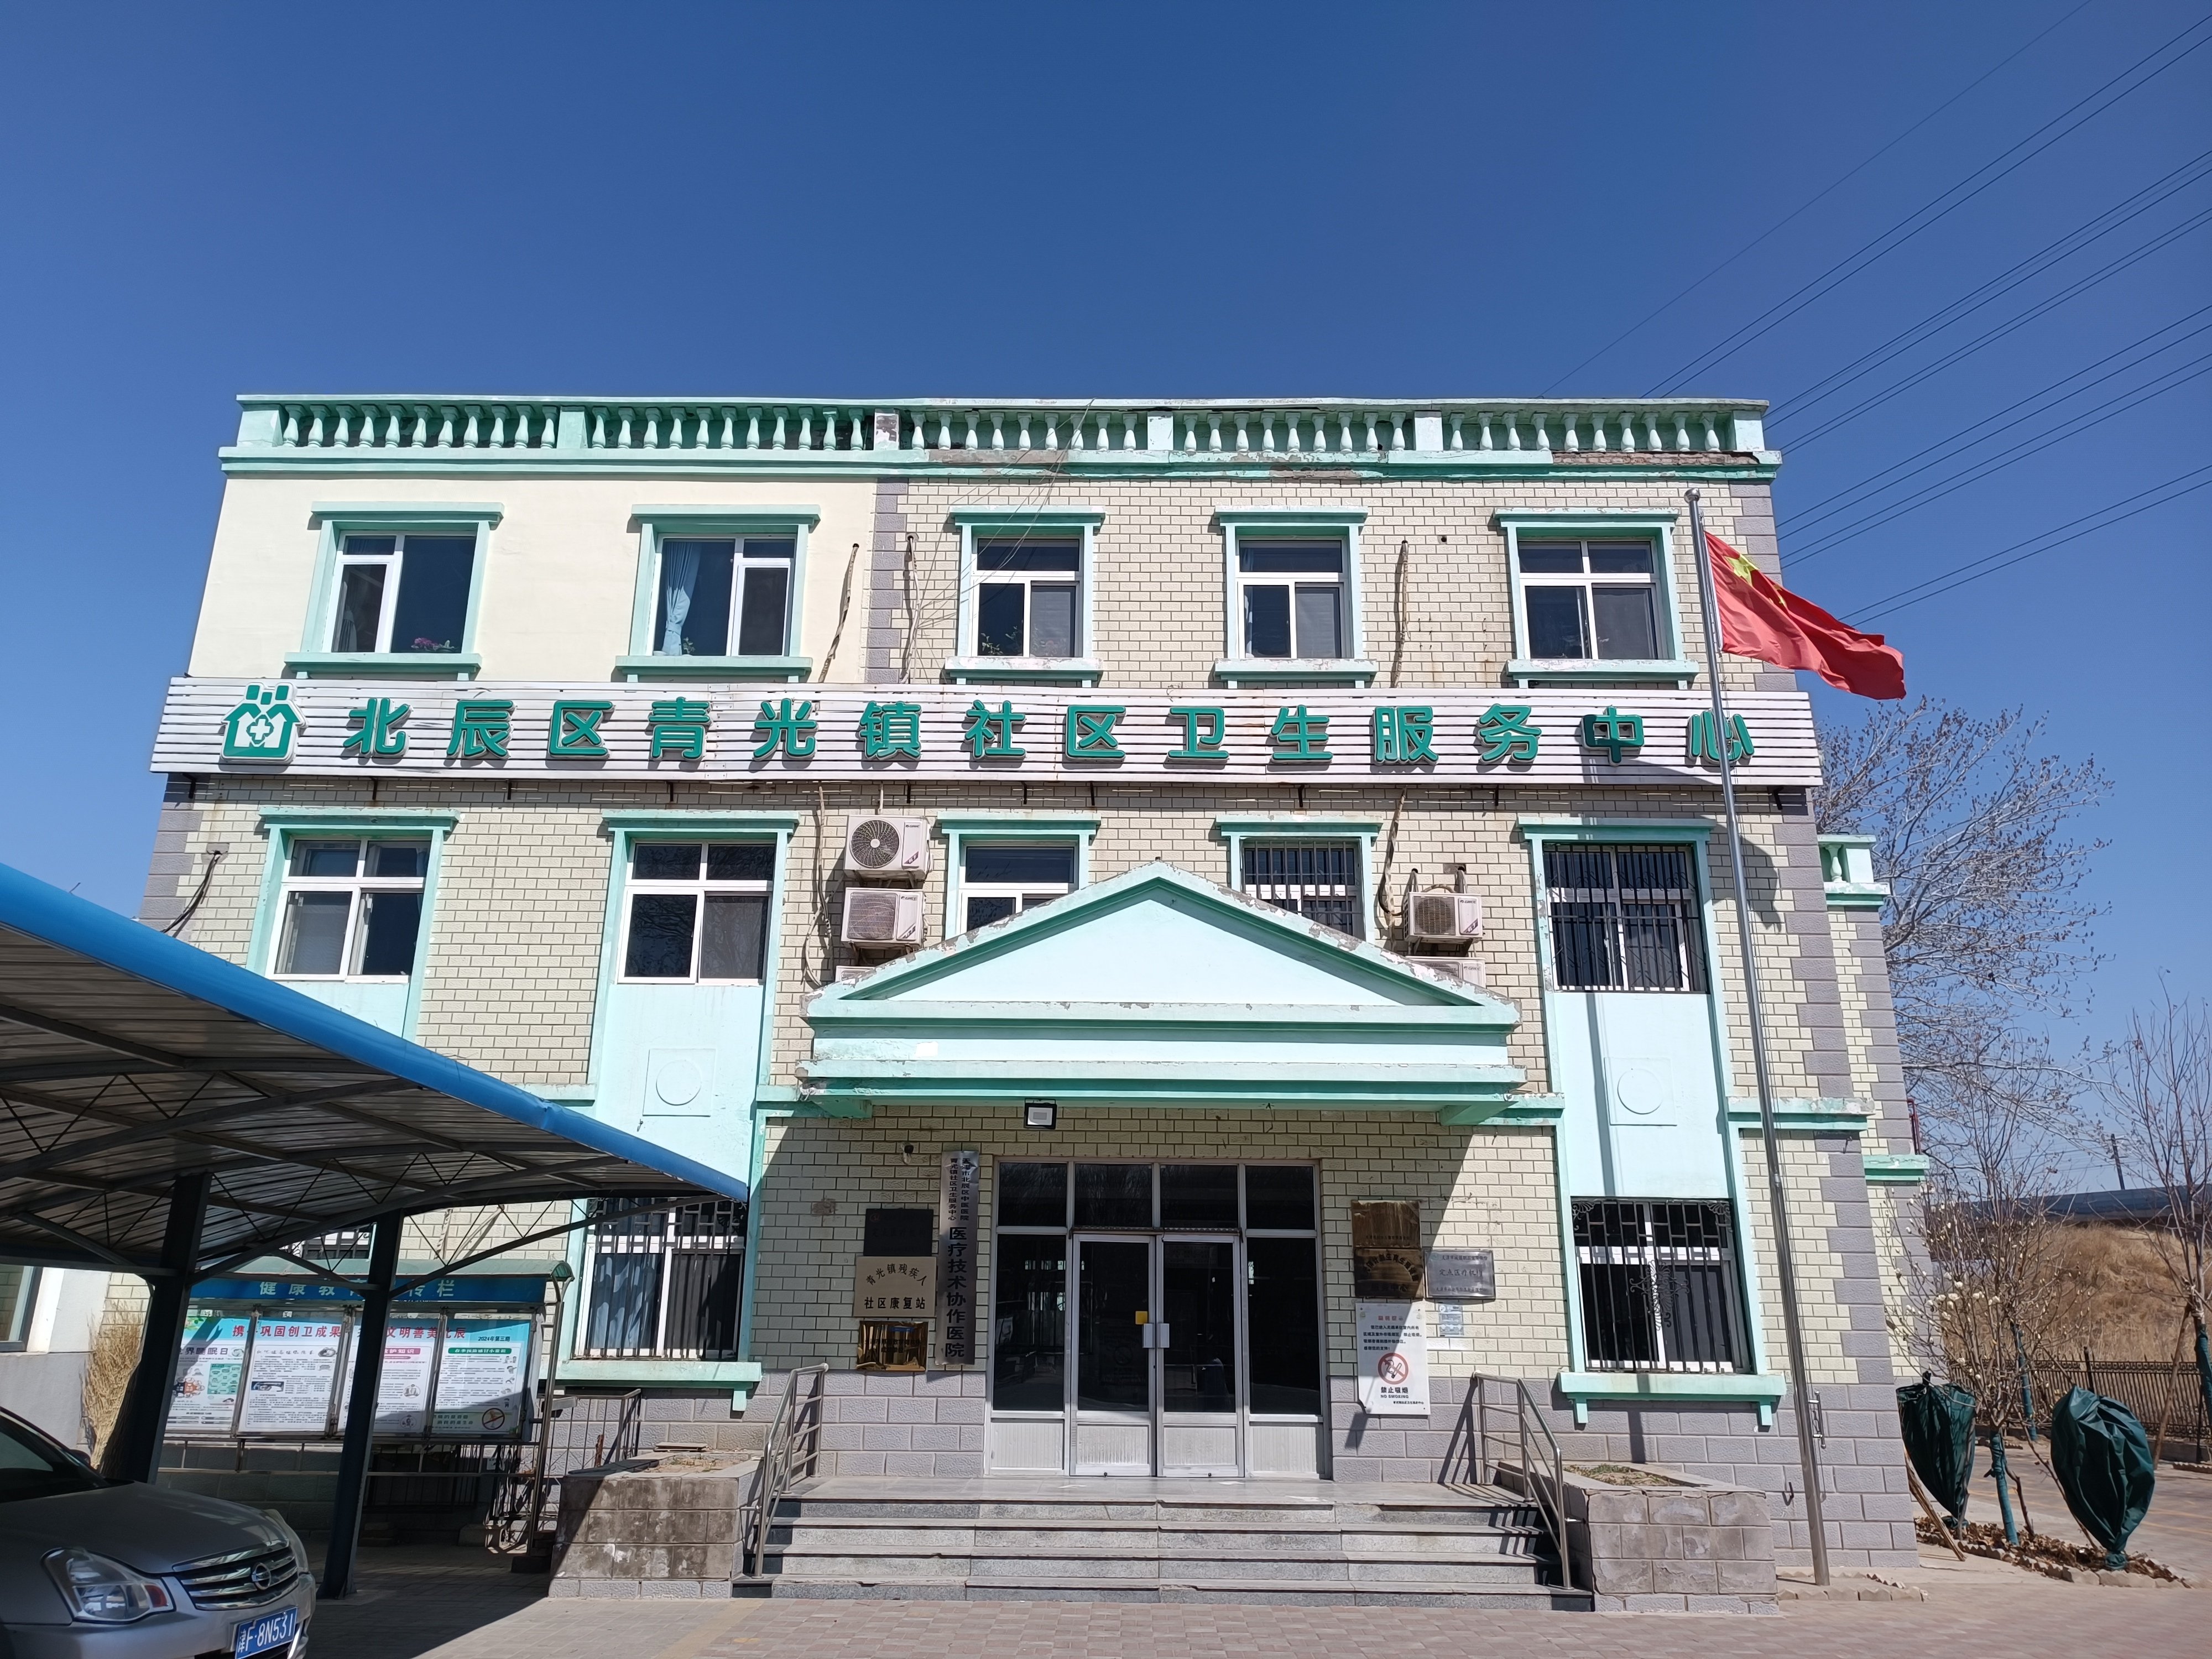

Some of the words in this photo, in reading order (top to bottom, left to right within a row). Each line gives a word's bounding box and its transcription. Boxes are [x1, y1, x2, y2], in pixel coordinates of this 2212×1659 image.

[343, 697, 1755, 768] 北辰区青光镇社区卫生服务中心
[948, 1158, 958, 1221] 青光镇社区卫生服务中心
[865, 1263, 927, 1286] 青光镇残疾人
[945, 1227, 968, 1358] 医疗技术协作医院
[864, 1296, 926, 1310] 社区康复站
[232, 1324, 341, 1338] 携巩固创卫成果
